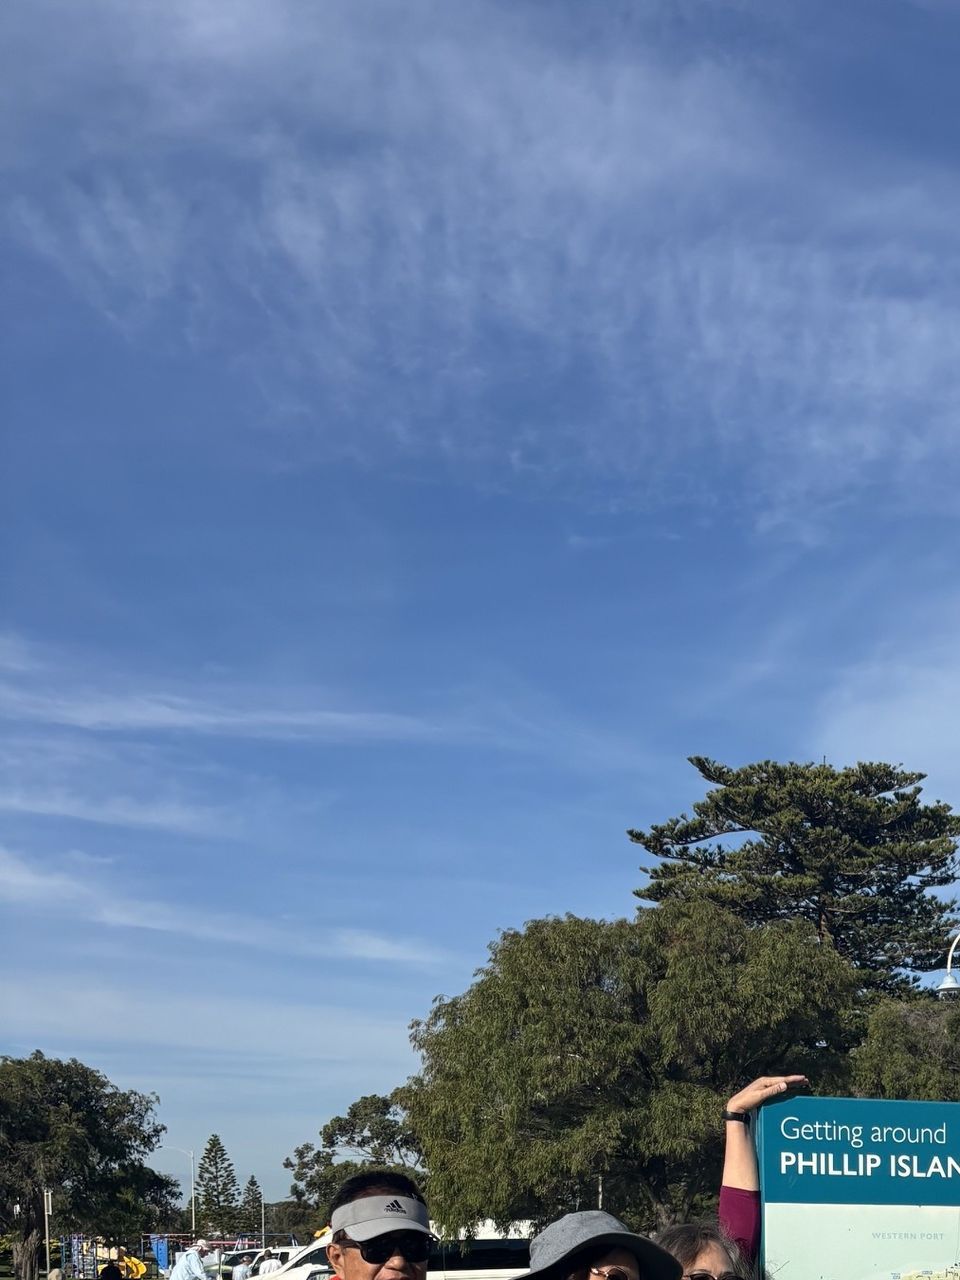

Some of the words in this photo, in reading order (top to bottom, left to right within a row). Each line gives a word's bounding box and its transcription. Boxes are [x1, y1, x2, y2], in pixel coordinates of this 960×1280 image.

[780, 1116, 864, 1148] Getting
[871, 1122, 946, 1144] around
[780, 1152, 881, 1176] PHILLIP
[871, 1232, 917, 1240] WESTERN
[920, 1232, 945, 1240] PORT
